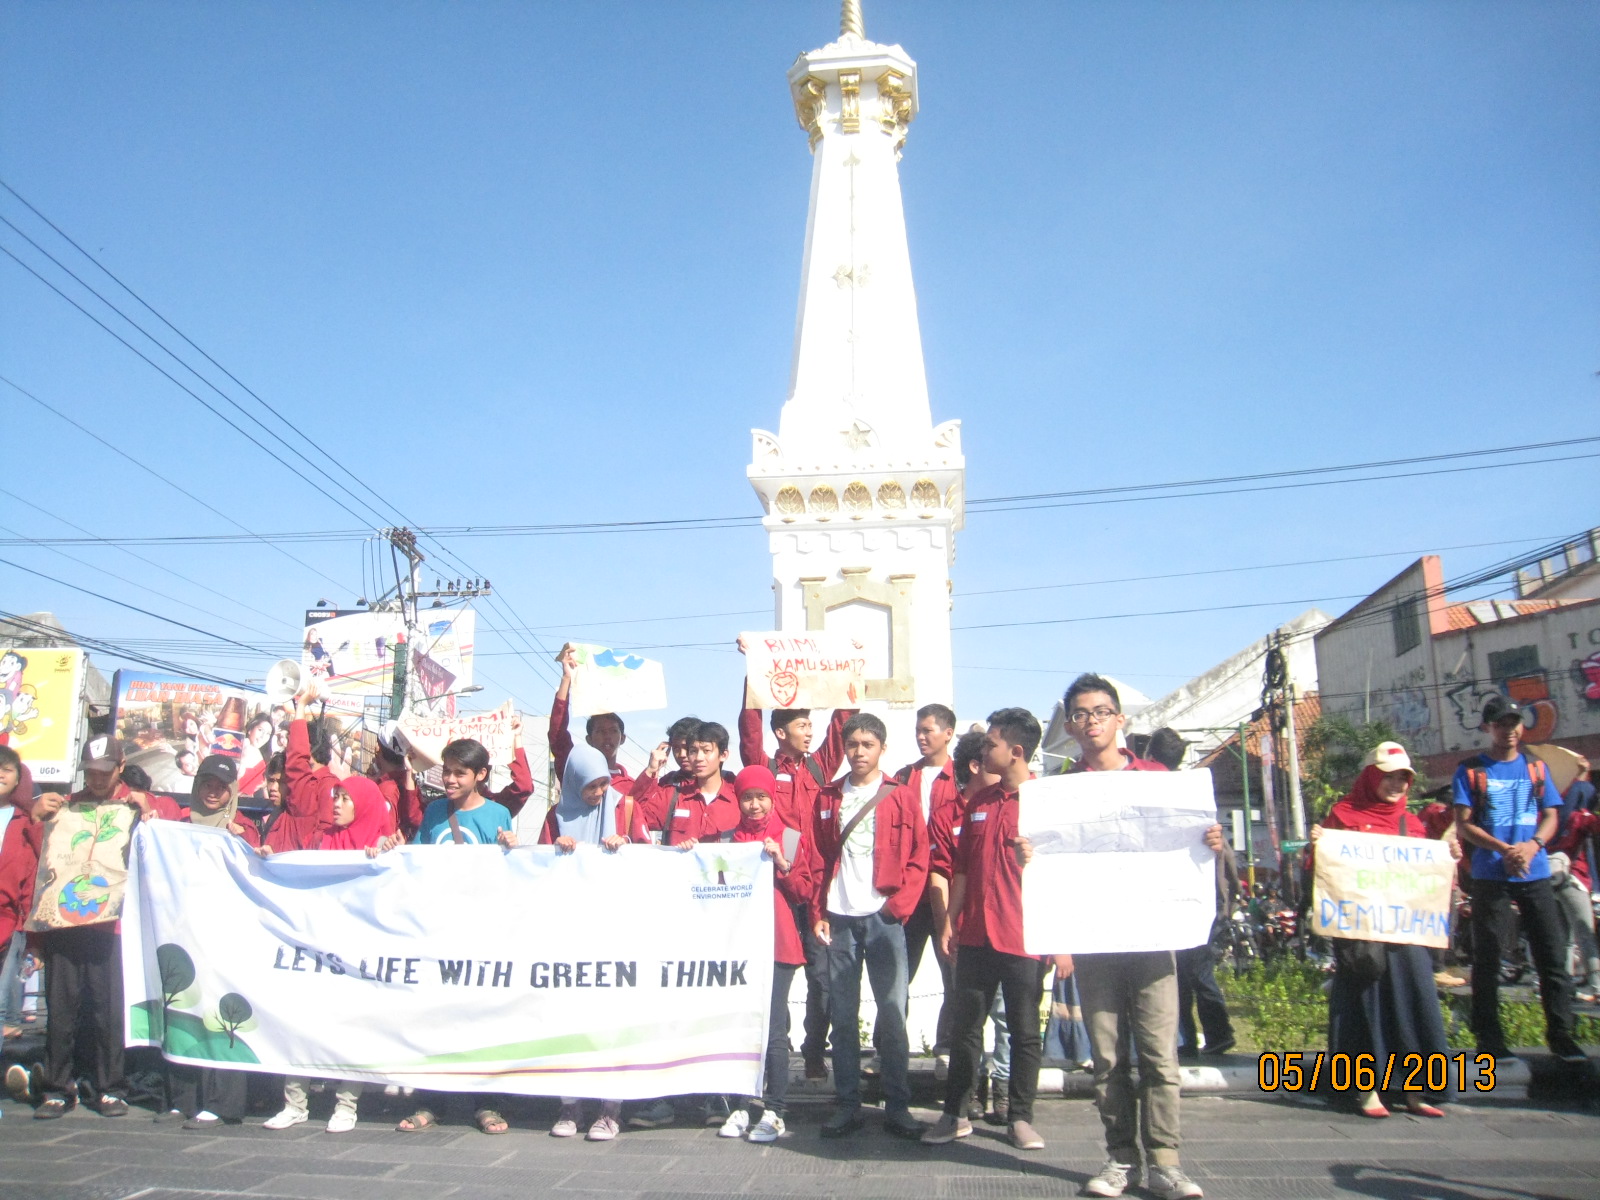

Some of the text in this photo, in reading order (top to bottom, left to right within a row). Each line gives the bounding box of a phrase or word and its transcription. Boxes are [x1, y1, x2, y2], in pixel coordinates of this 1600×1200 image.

[772, 658, 865, 676] KAMU SEHAT?
[412, 723, 504, 736] YOU KOMPOR
[1340, 844, 1435, 863] AKU CINTA
[1320, 899, 1383, 934] DEMI
[273, 945, 748, 988] LETS LIFE WITH GREEN THINK
